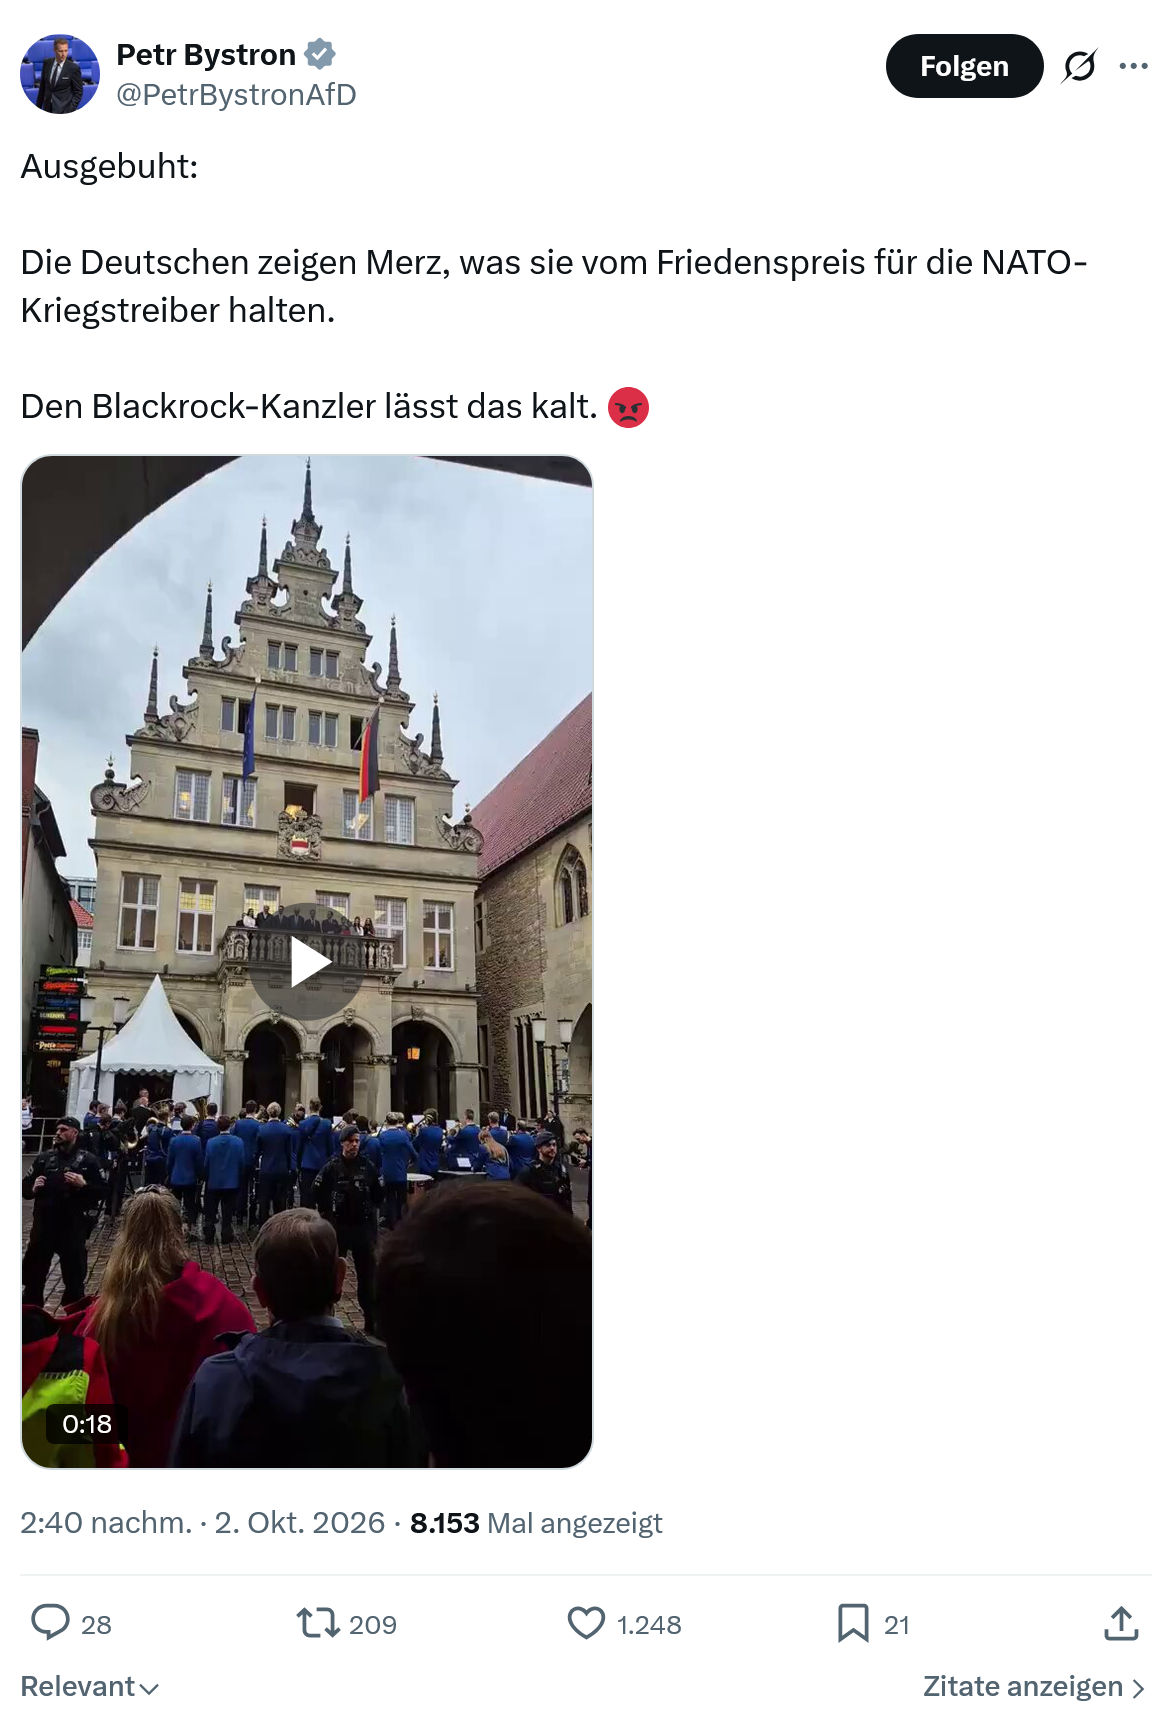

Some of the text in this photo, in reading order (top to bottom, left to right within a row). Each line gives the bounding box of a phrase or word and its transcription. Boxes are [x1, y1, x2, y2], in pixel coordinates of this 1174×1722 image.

[117, 43, 296, 72] Petr Bystron
[921, 54, 1009, 82] Folgen
[117, 81, 357, 112] @PetrBystronAfD
[20, 152, 197, 186] Ausgebuht:
[22, 248, 1087, 281] Die Deutschen zeigen Merz, was sie vom Friedenspreis für die NATO-
[22, 296, 335, 329] Kriegstreiber halten.
[22, 392, 597, 419] Den Blackrock-Kanzler lässt das kalt.
[20, 1509, 664, 1539] 2:40 nachm. 2. Okt. 2026 8.153 Mal angezeigt
[81, 1615, 112, 1635] 28
[349, 1615, 397, 1635] 209
[617, 1615, 682, 1635] 1.248
[884, 1615, 908, 1635] 21
[21, 1674, 136, 1697] Relevant
[923, 1674, 1123, 1702] Zitate anzeigen
